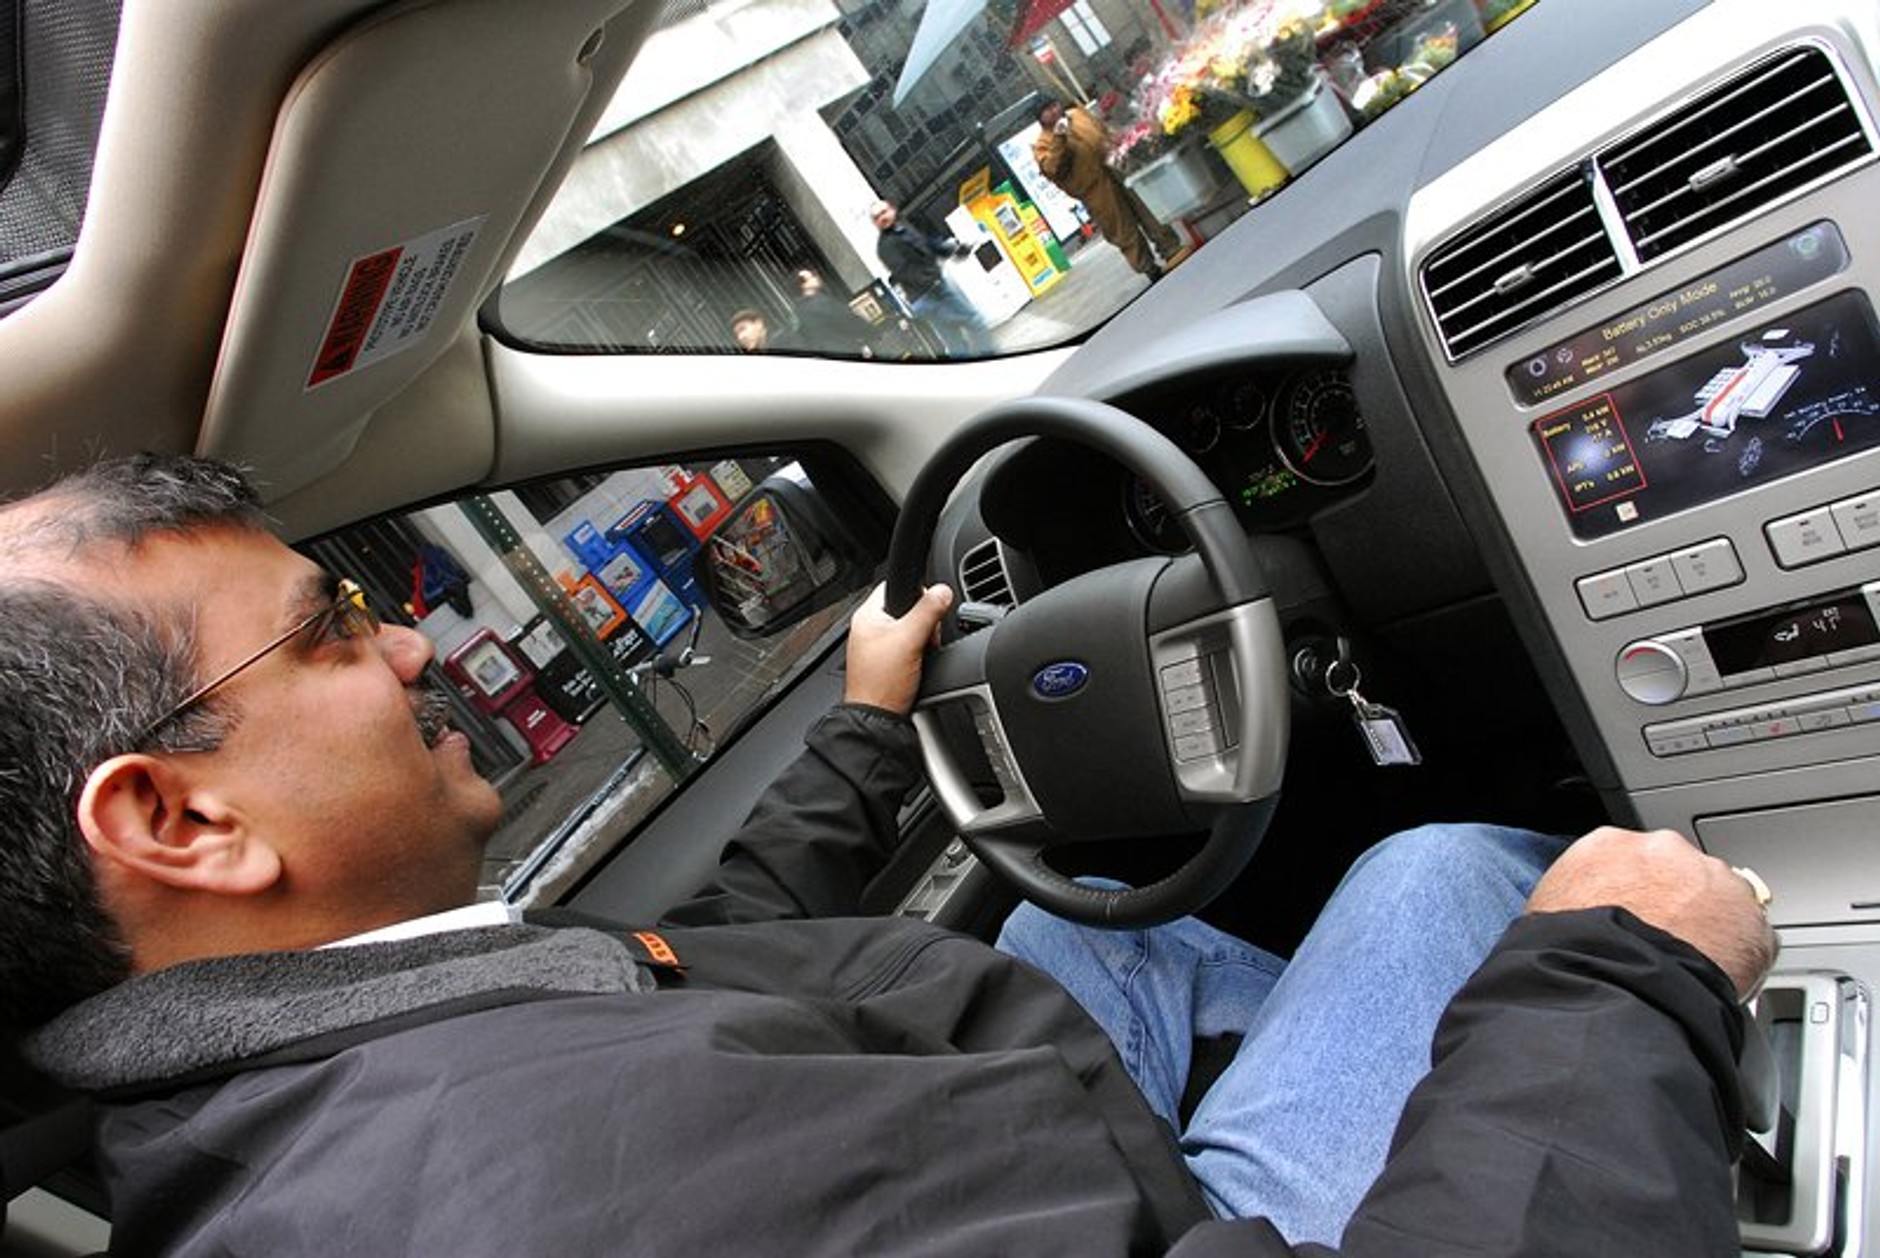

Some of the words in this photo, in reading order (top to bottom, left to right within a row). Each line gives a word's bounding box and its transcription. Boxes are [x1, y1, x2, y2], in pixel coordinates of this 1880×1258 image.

[330, 255, 393, 348] WARNING
[1602, 314, 1646, 340] Battery
[1647, 301, 1677, 320] Only
[1680, 283, 1717, 304] Mode
